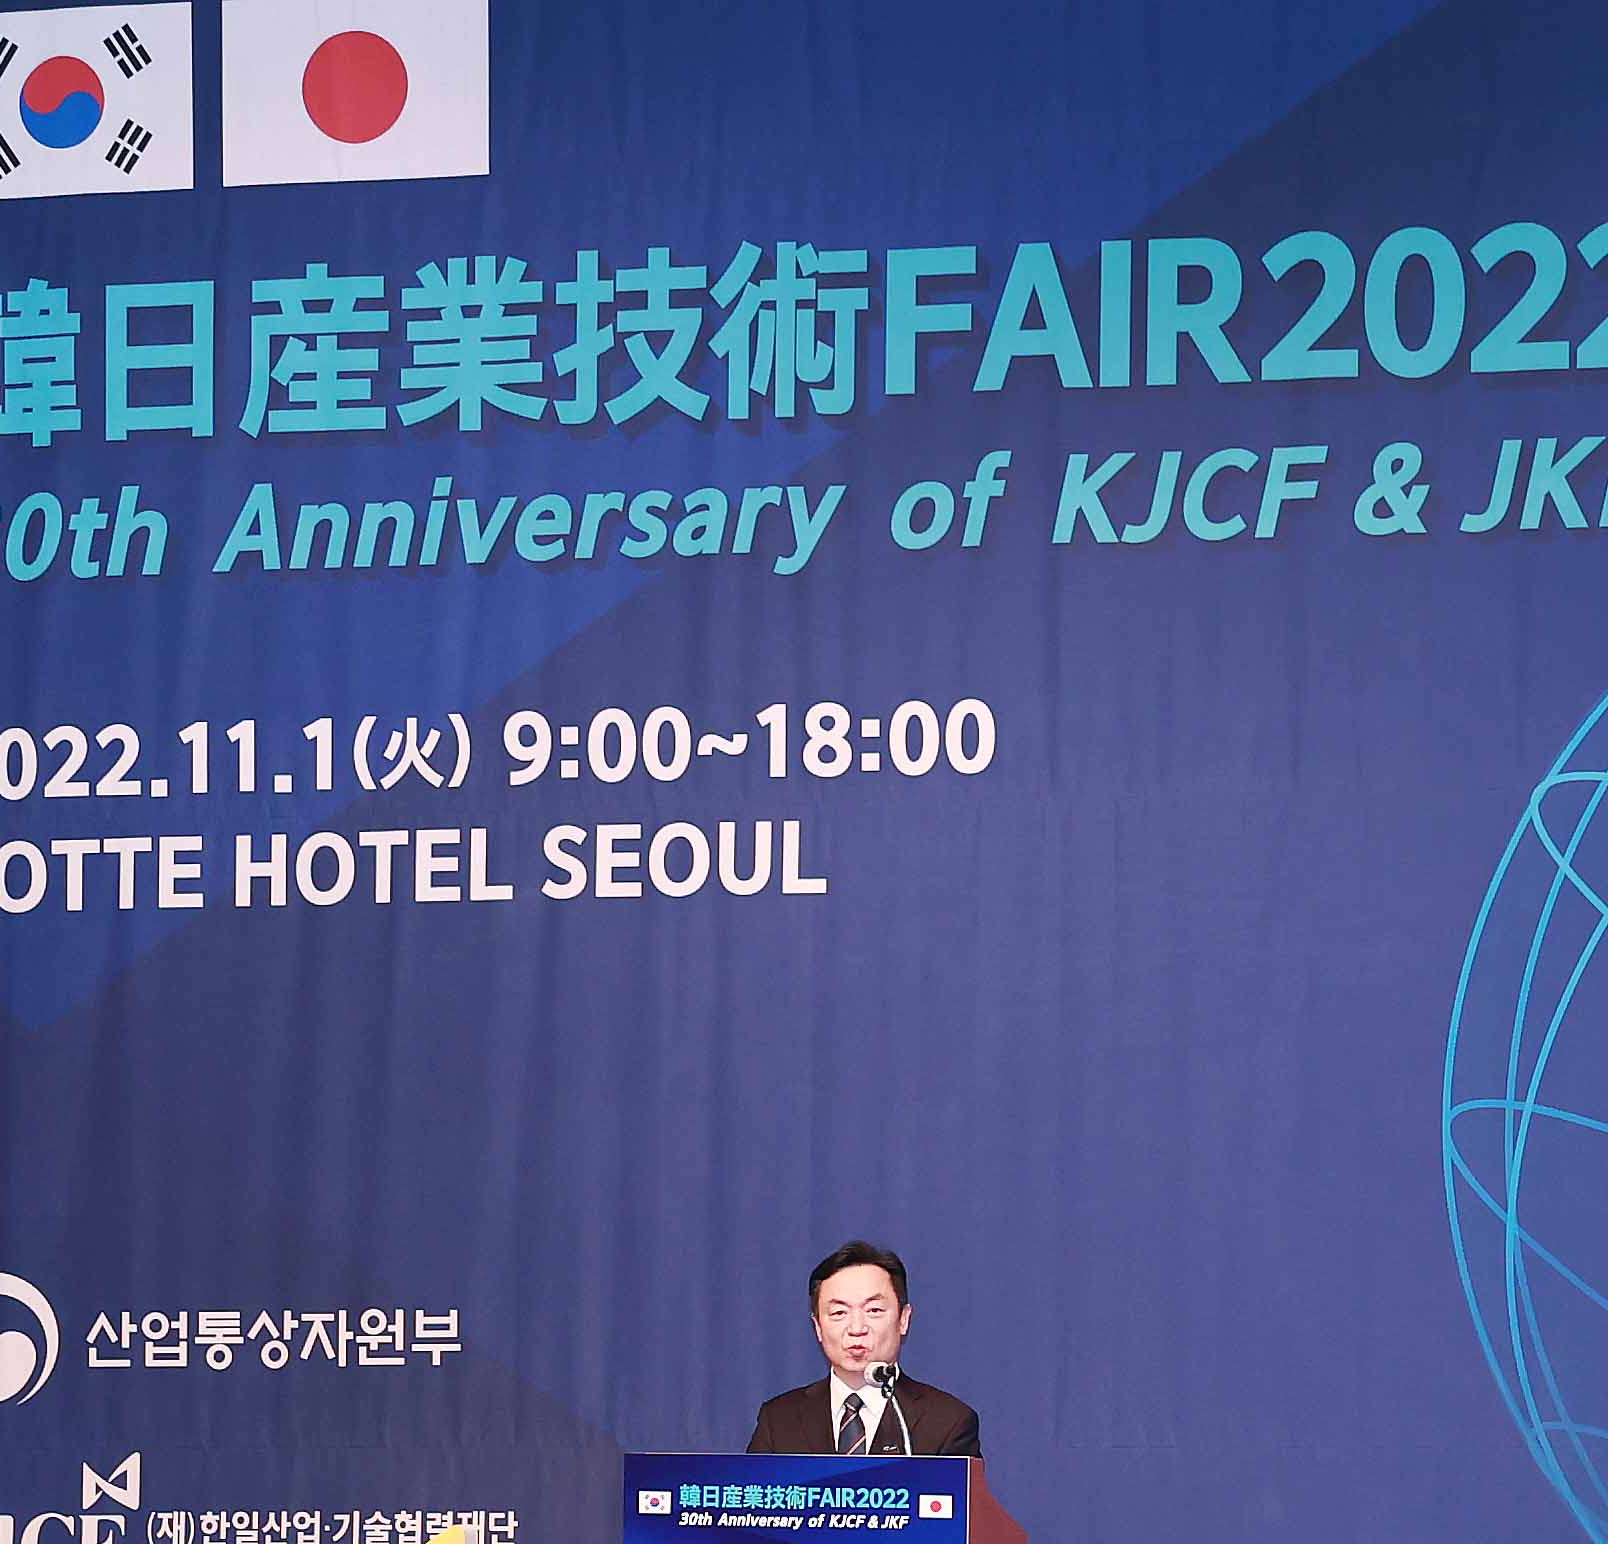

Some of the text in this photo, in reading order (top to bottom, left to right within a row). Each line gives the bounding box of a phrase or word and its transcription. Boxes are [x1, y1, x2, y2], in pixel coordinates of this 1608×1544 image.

[212, 476, 848, 576] Anniversary
[891, 451, 1013, 551] of
[1052, 446, 1330, 545] KJCF
[1354, 443, 1431, 537] &
[504, 699, 998, 788] 9:00~18:00
[236, 829, 516, 908] HOTEL
[542, 821, 829, 901] SEOUL
[86, 1308, 463, 1371] 산업통상자원부
[678, 1512, 911, 1530] 30th Anniversary of KJCF & JKF
[680, 1484, 911, 1510] 韓日産業技術FAIR2022
